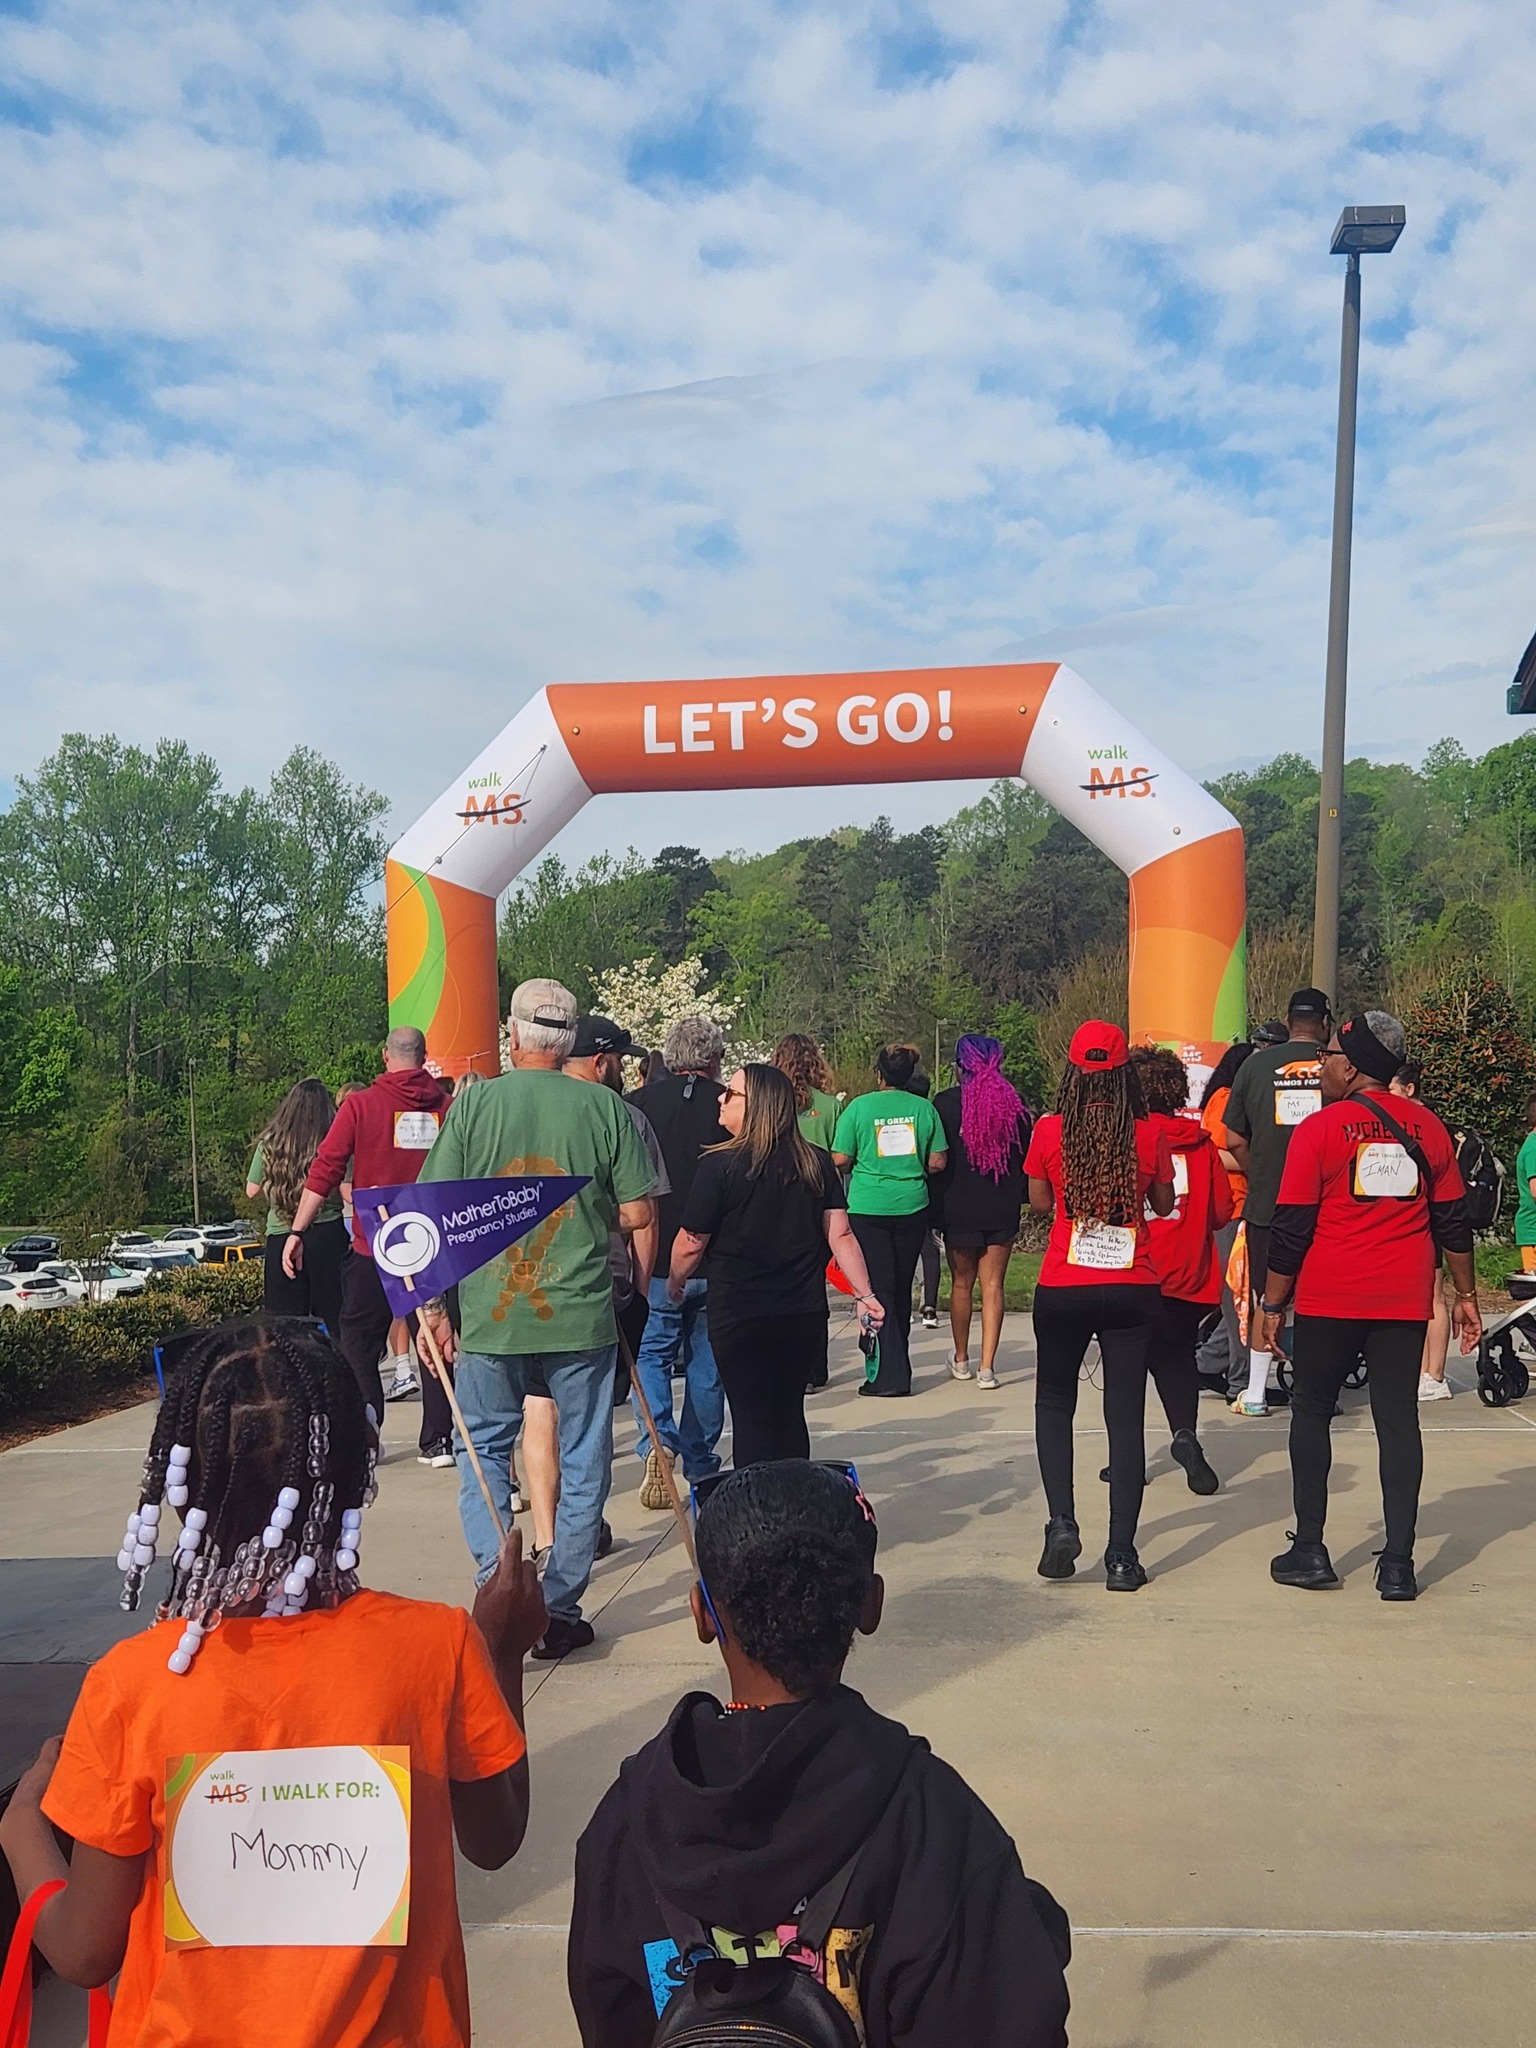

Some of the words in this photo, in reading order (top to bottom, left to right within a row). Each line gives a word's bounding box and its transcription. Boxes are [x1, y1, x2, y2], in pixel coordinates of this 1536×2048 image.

[644, 697, 819, 754] LET'S
[836, 690, 953, 746] GO!
[1087, 744, 1129, 760] walk
[468, 772, 502, 789] walk
[1273, 1079, 1302, 1087] VAMOS
[874, 1118, 886, 1126] BE
[887, 1116, 915, 1125] GREAT
[1342, 1120, 1423, 1142] MICHELE
[1362, 1160, 1402, 1178] IMAN
[447, 1217, 505, 1247] Pregnancy
[505, 1206, 538, 1226] Studies
[210, 1770, 235, 1781] walk
[262, 1786, 267, 1802] I
[272, 1782, 330, 1801] WALK
[335, 1781, 380, 1799] FOR:
[231, 1828, 368, 1891] Mommy
